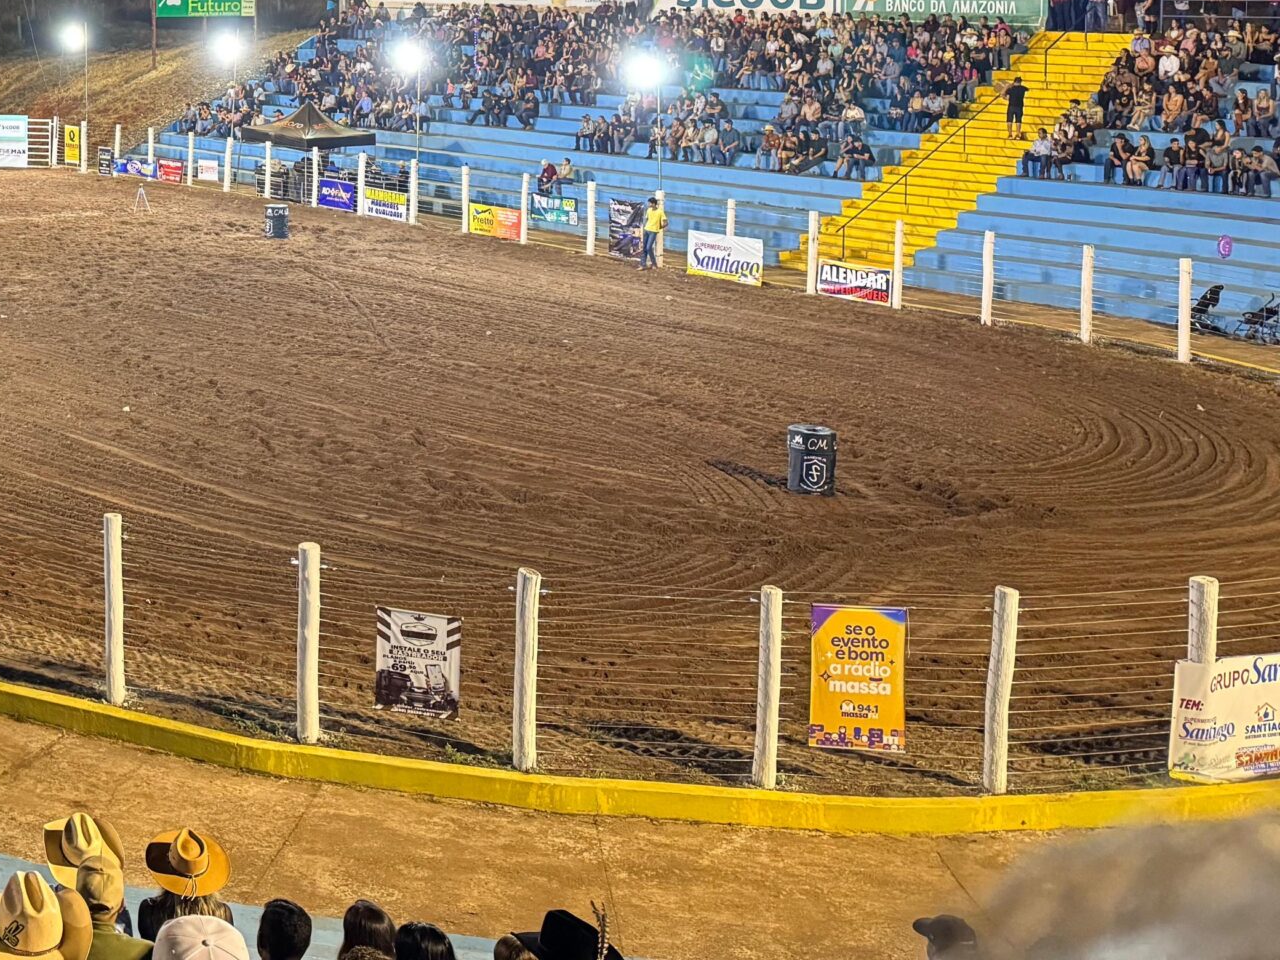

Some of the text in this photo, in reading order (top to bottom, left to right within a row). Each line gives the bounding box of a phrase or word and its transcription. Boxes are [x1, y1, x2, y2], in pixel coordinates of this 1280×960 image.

[885, 0, 1017, 15] BANCO DA AMAZONIA
[472, 214, 494, 226] Pretto
[690, 247, 760, 280] Santiago
[821, 264, 888, 291] ALENCAR
[845, 625, 876, 636] se o
[390, 644, 421, 653] INSTALE
[831, 636, 890, 649] evento
[835, 644, 885, 662] é bom
[829, 661, 891, 678] a rádio
[829, 679, 892, 696] massa
[1210, 668, 1250, 693] GRUPO
[857, 703, 879, 714] 94.1
[1179, 697, 1205, 711] TEM:
[841, 711, 869, 719] massa
